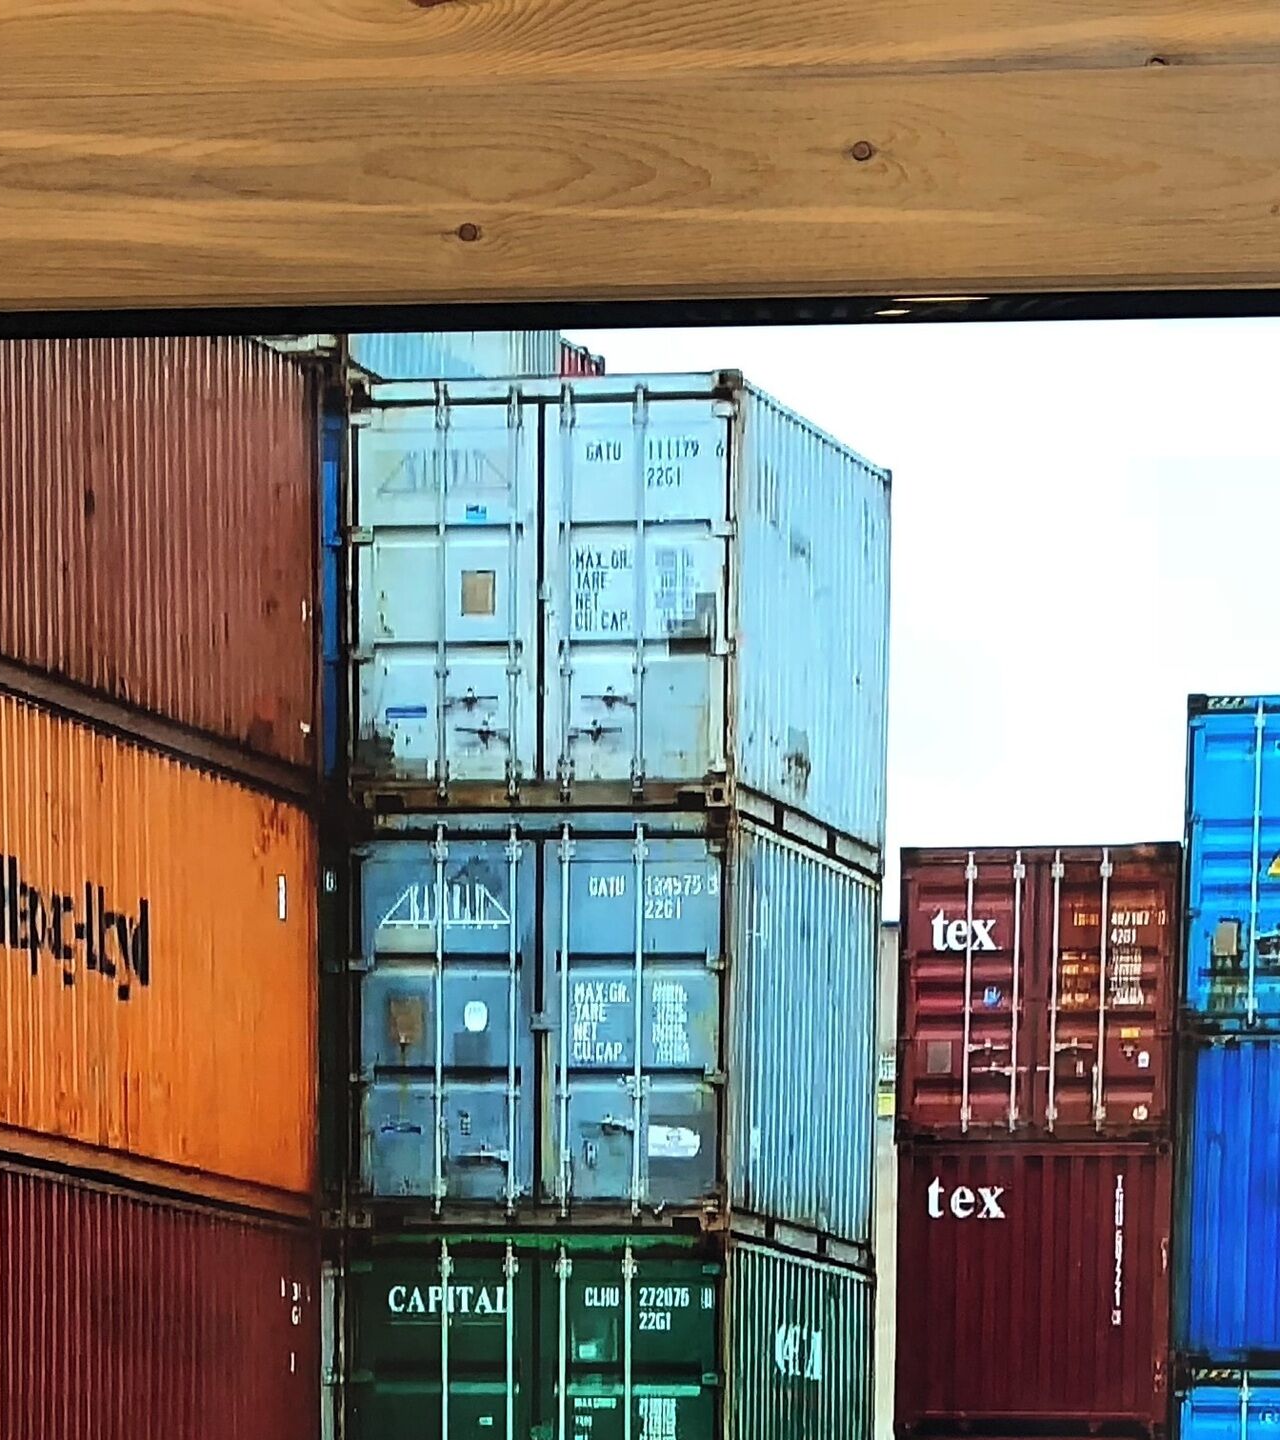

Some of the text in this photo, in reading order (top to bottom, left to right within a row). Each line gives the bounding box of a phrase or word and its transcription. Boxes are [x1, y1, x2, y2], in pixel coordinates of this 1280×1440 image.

[931, 908, 1000, 951] tex
[927, 1175, 1006, 1219] tex
[388, 1285, 508, 1313] CAPITAL
